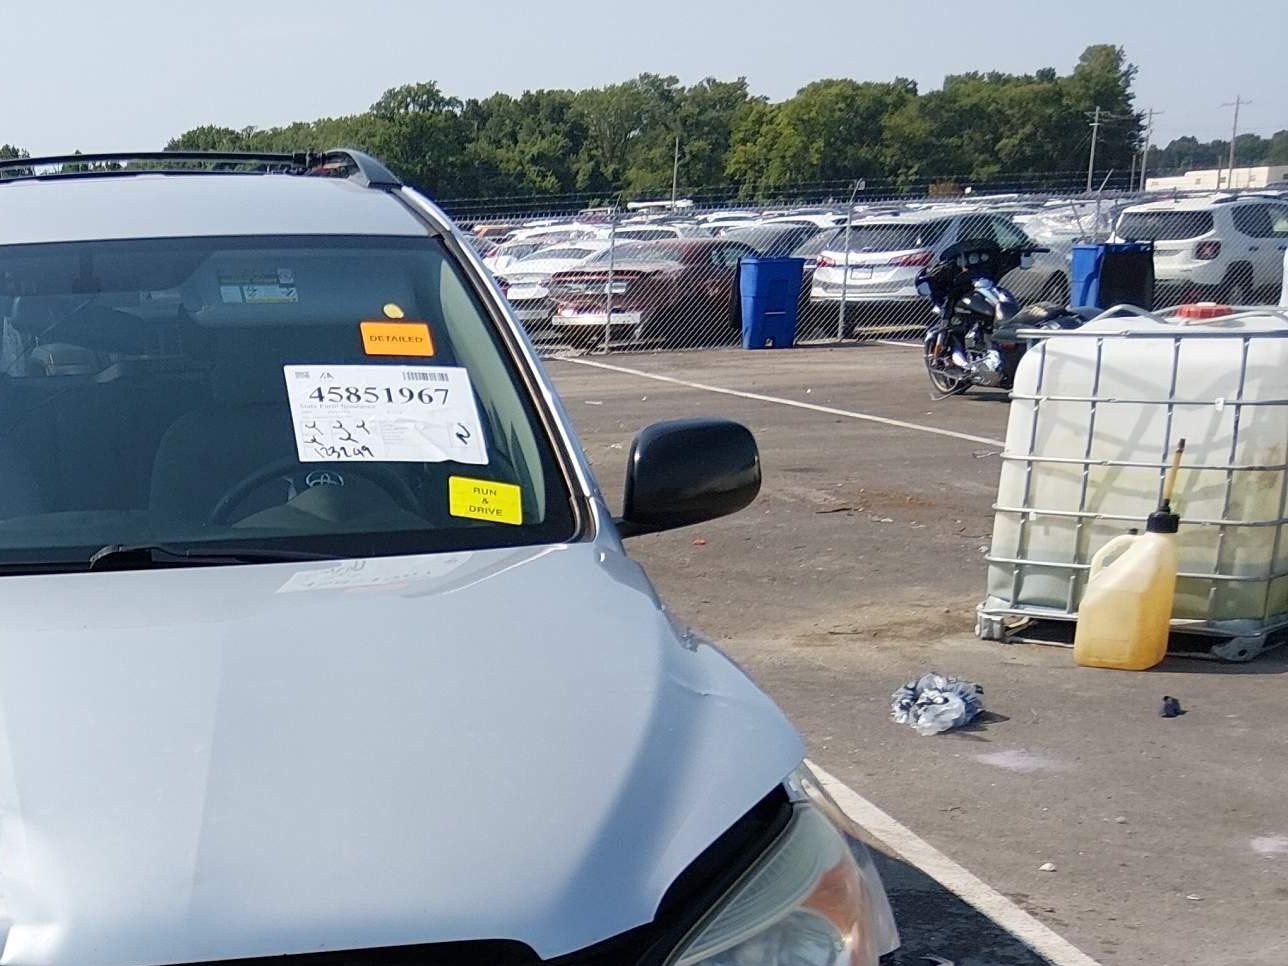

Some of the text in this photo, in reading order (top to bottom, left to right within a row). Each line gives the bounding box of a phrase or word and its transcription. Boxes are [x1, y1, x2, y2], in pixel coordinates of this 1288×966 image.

[369, 335, 423, 343] DETAILED
[309, 386, 450, 405] 45851967
[473, 487, 497, 496] RUN
[468, 504, 503, 517] DRIVE
